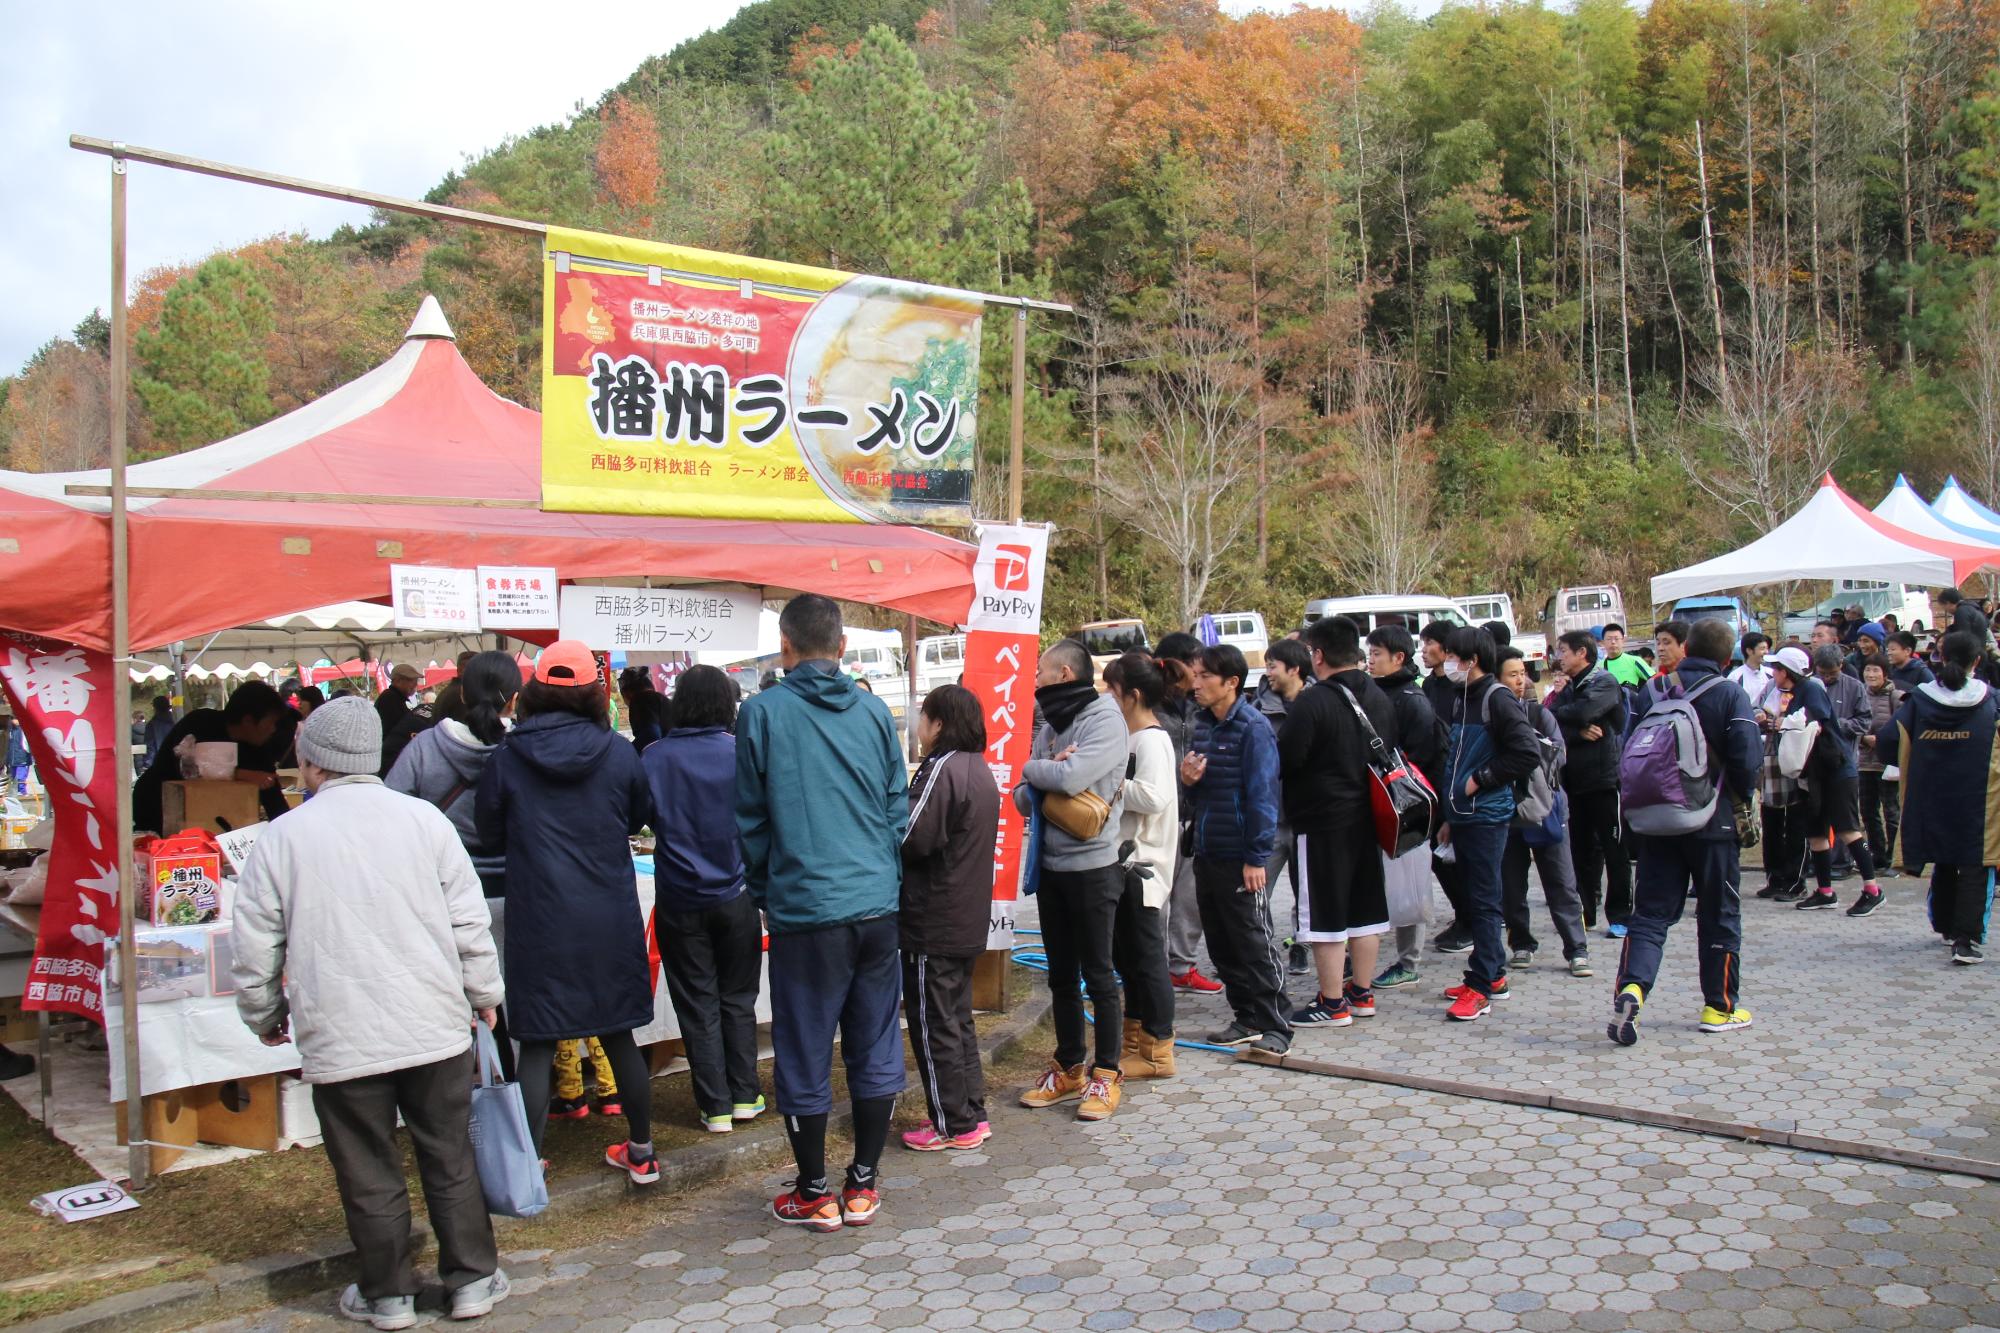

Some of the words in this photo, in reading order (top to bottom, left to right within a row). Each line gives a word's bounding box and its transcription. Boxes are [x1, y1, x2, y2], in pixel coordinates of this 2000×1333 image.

[633, 301, 758, 329] 播州ラーメン発祥の地
[633, 324, 758, 351] 兵庫県西脇市・多可町
[591, 357, 960, 455] 播州ラーメン
[591, 453, 712, 477] 西脇多可料飲組合
[728, 462, 809, 483] ラーメン部会
[486, 577, 541, 591] 食券売場
[595, 595, 734, 619] 西脇多可料飲組合
[983, 596, 1036, 619] PayPay
[615, 623, 713, 645] 播州ラーメン
[173, 867, 203, 882] 播州
[163, 883, 213, 898] ラーメン
